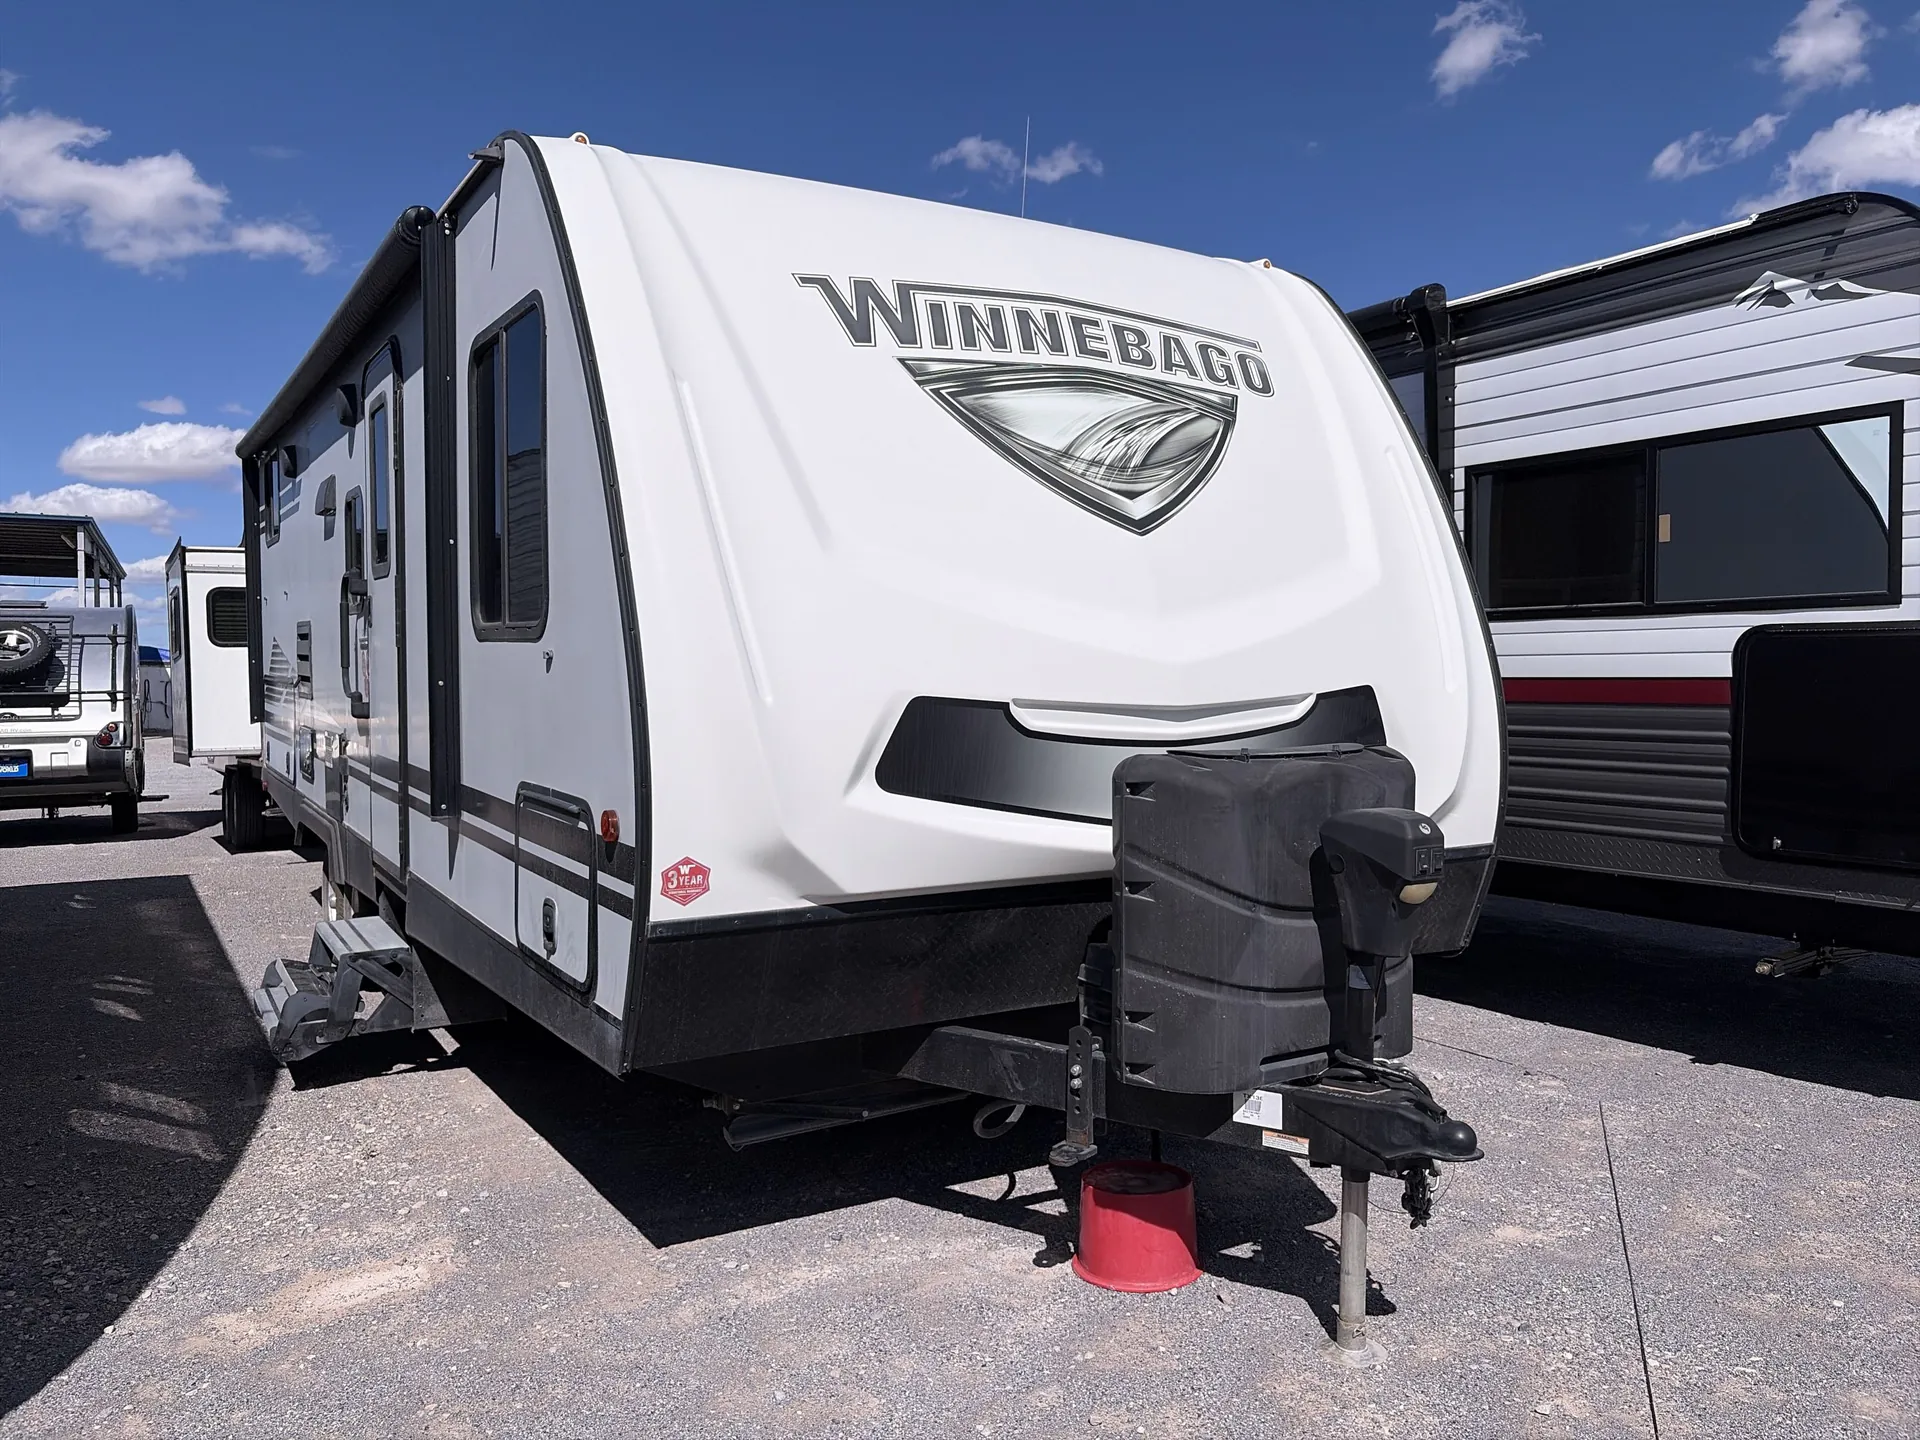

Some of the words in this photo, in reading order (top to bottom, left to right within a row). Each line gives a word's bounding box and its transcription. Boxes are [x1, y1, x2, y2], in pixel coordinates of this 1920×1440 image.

[791, 273, 1275, 398] WINNEBAGO
[667, 870, 678, 889] 3
[679, 874, 703, 886] YEAR
